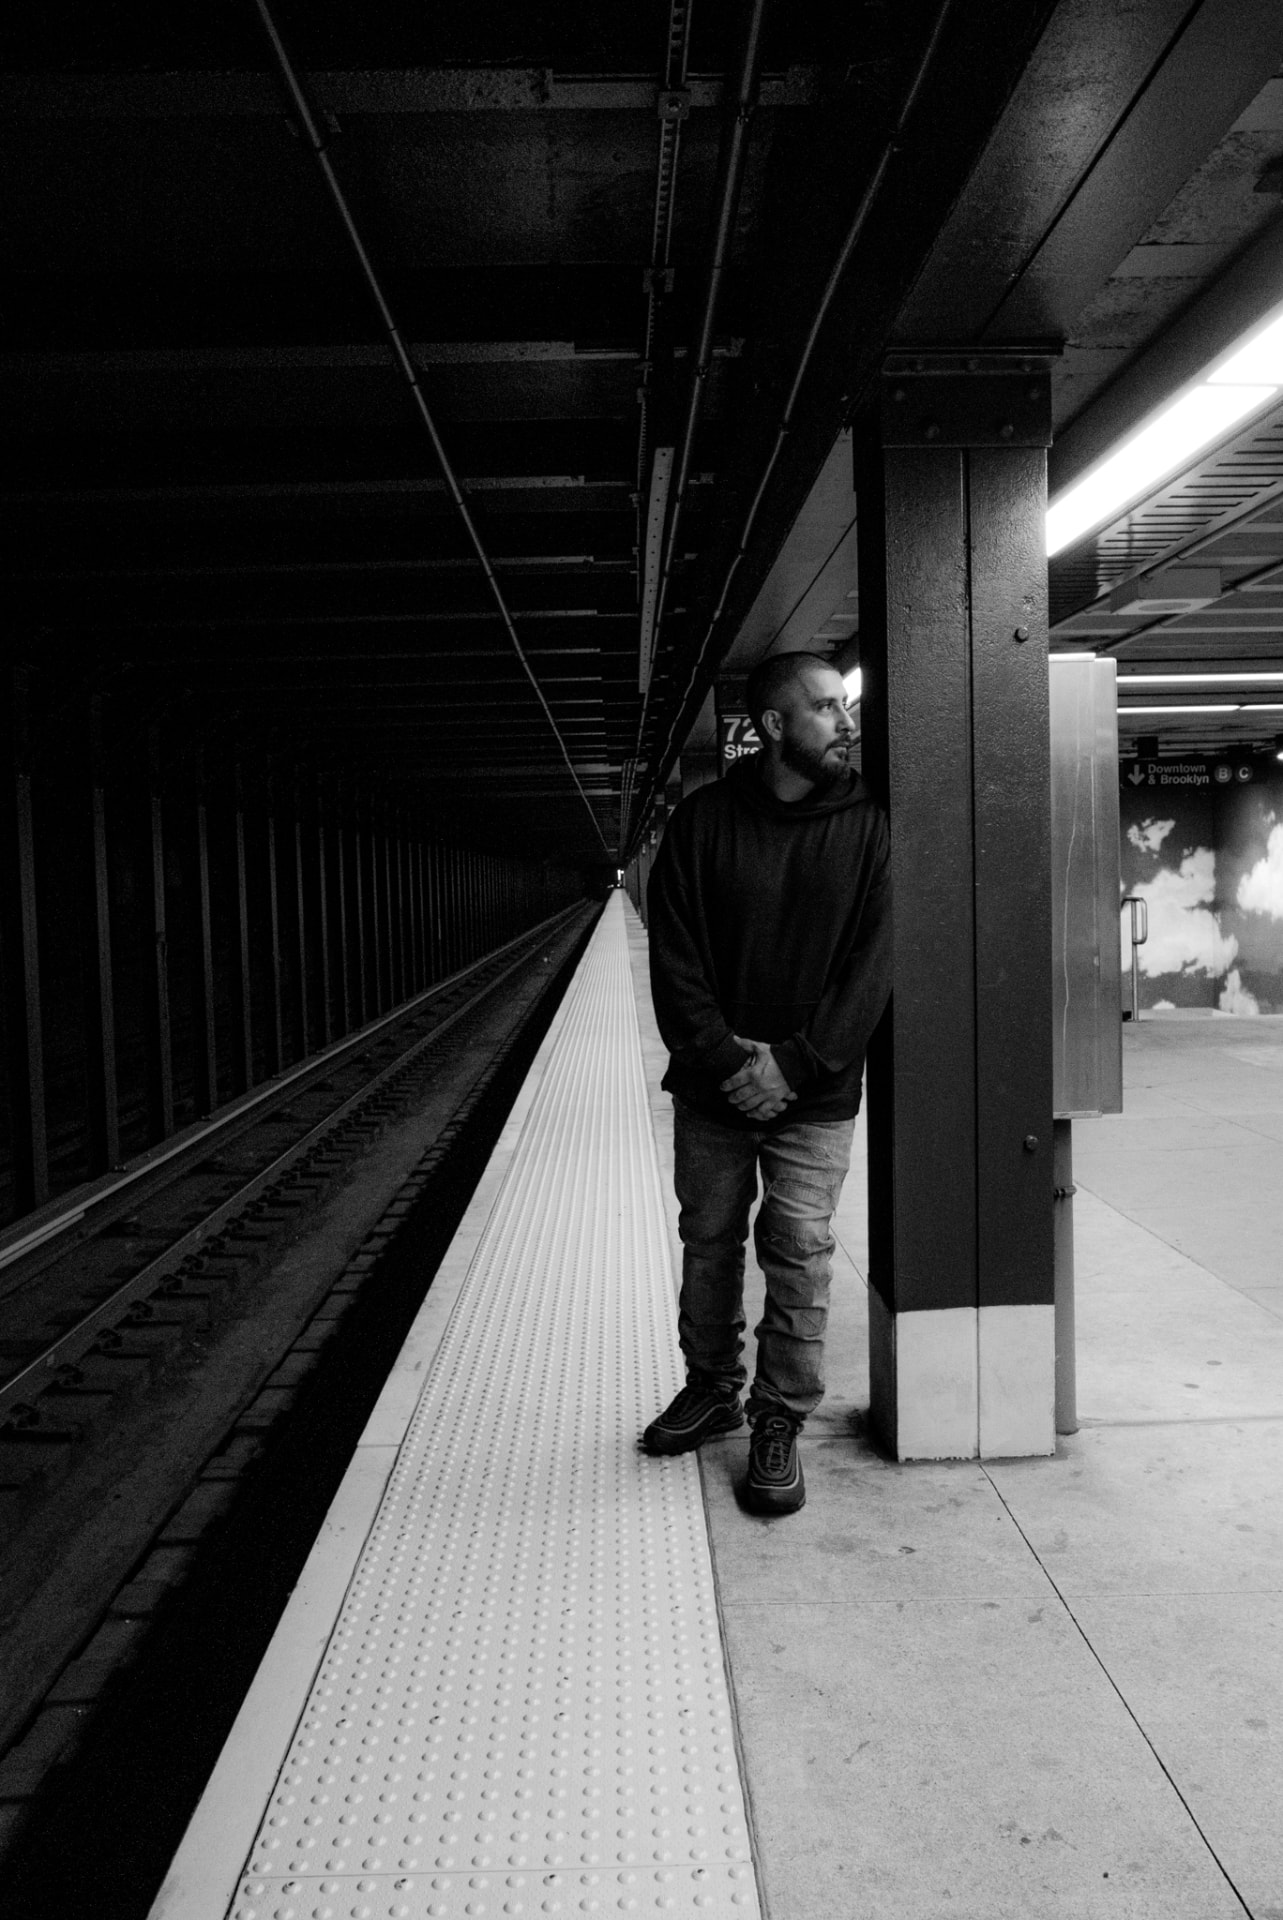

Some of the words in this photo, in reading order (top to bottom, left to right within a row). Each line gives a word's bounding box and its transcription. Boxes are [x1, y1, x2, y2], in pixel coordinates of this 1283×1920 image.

[723, 717, 760, 742] 72
[1148, 763, 1206, 774] Downtown
[1218, 768, 1228, 779] B
[1239, 768, 1249, 779] C
[1148, 775, 1156, 785] &
[1160, 774, 1210, 786] Brooklyn
